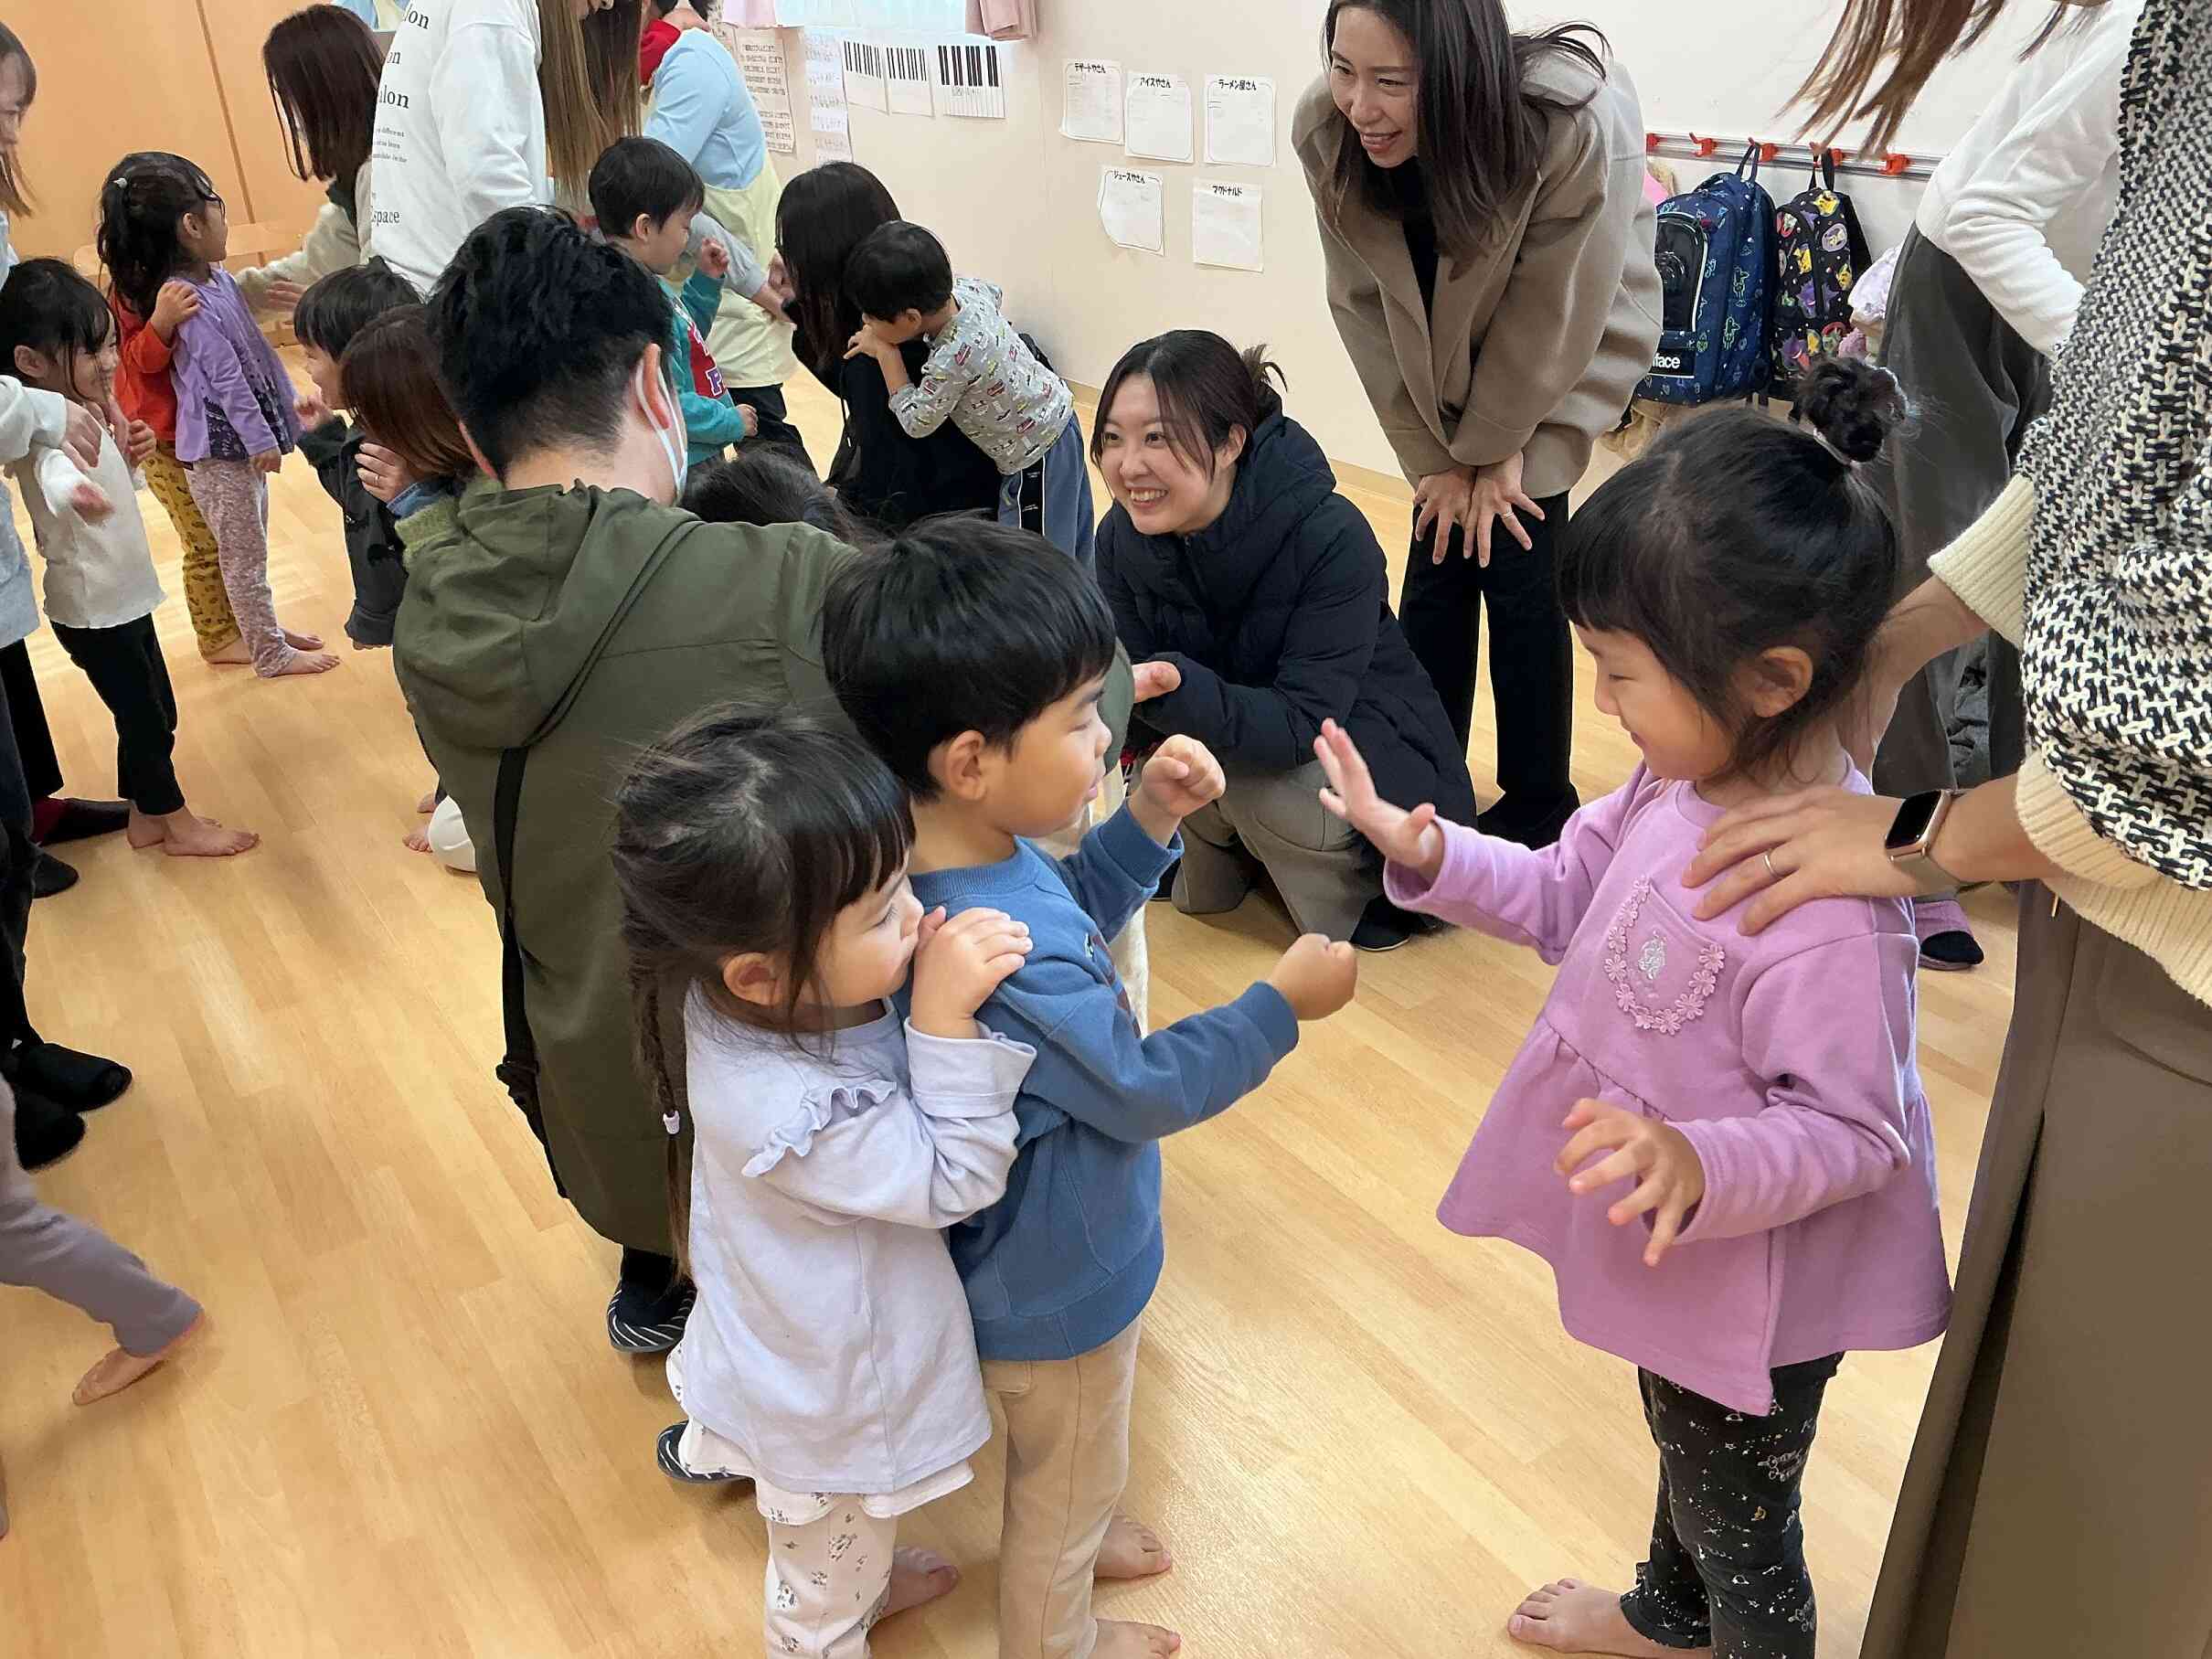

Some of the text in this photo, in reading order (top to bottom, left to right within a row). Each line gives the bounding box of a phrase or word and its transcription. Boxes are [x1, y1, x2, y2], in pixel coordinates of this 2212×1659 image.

[1140, 77, 1172, 89] アイスやさん
[1218, 79, 1257, 91] ラーメン屋さん
[1212, 185, 1243, 197] マクドナルド
[371, 206, 400, 227] space
